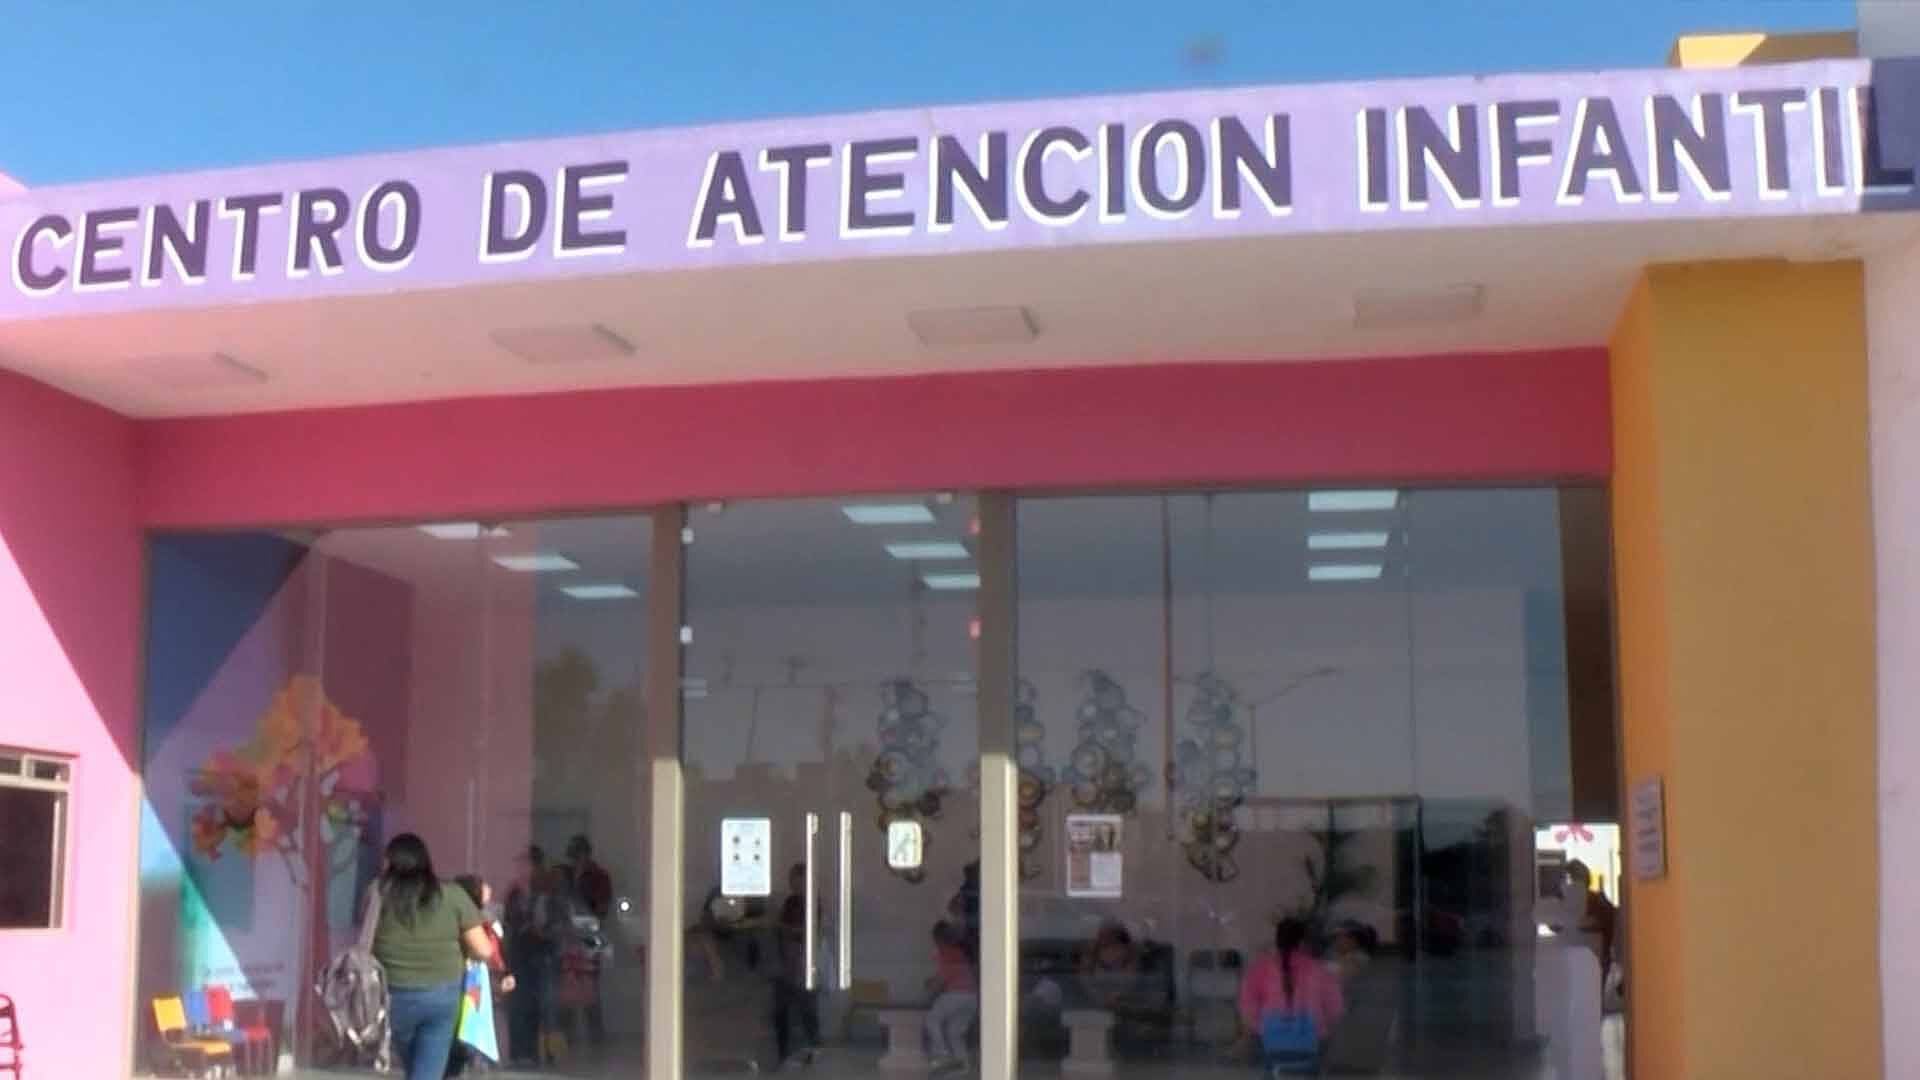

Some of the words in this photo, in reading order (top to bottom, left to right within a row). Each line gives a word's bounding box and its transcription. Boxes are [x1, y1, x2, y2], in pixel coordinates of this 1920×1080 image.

[12, 180, 422, 293] CENTRO
[478, 161, 630, 263] DE
[686, 113, 1292, 248] ATENCION
[1356, 86, 1916, 212] INFANTIL
